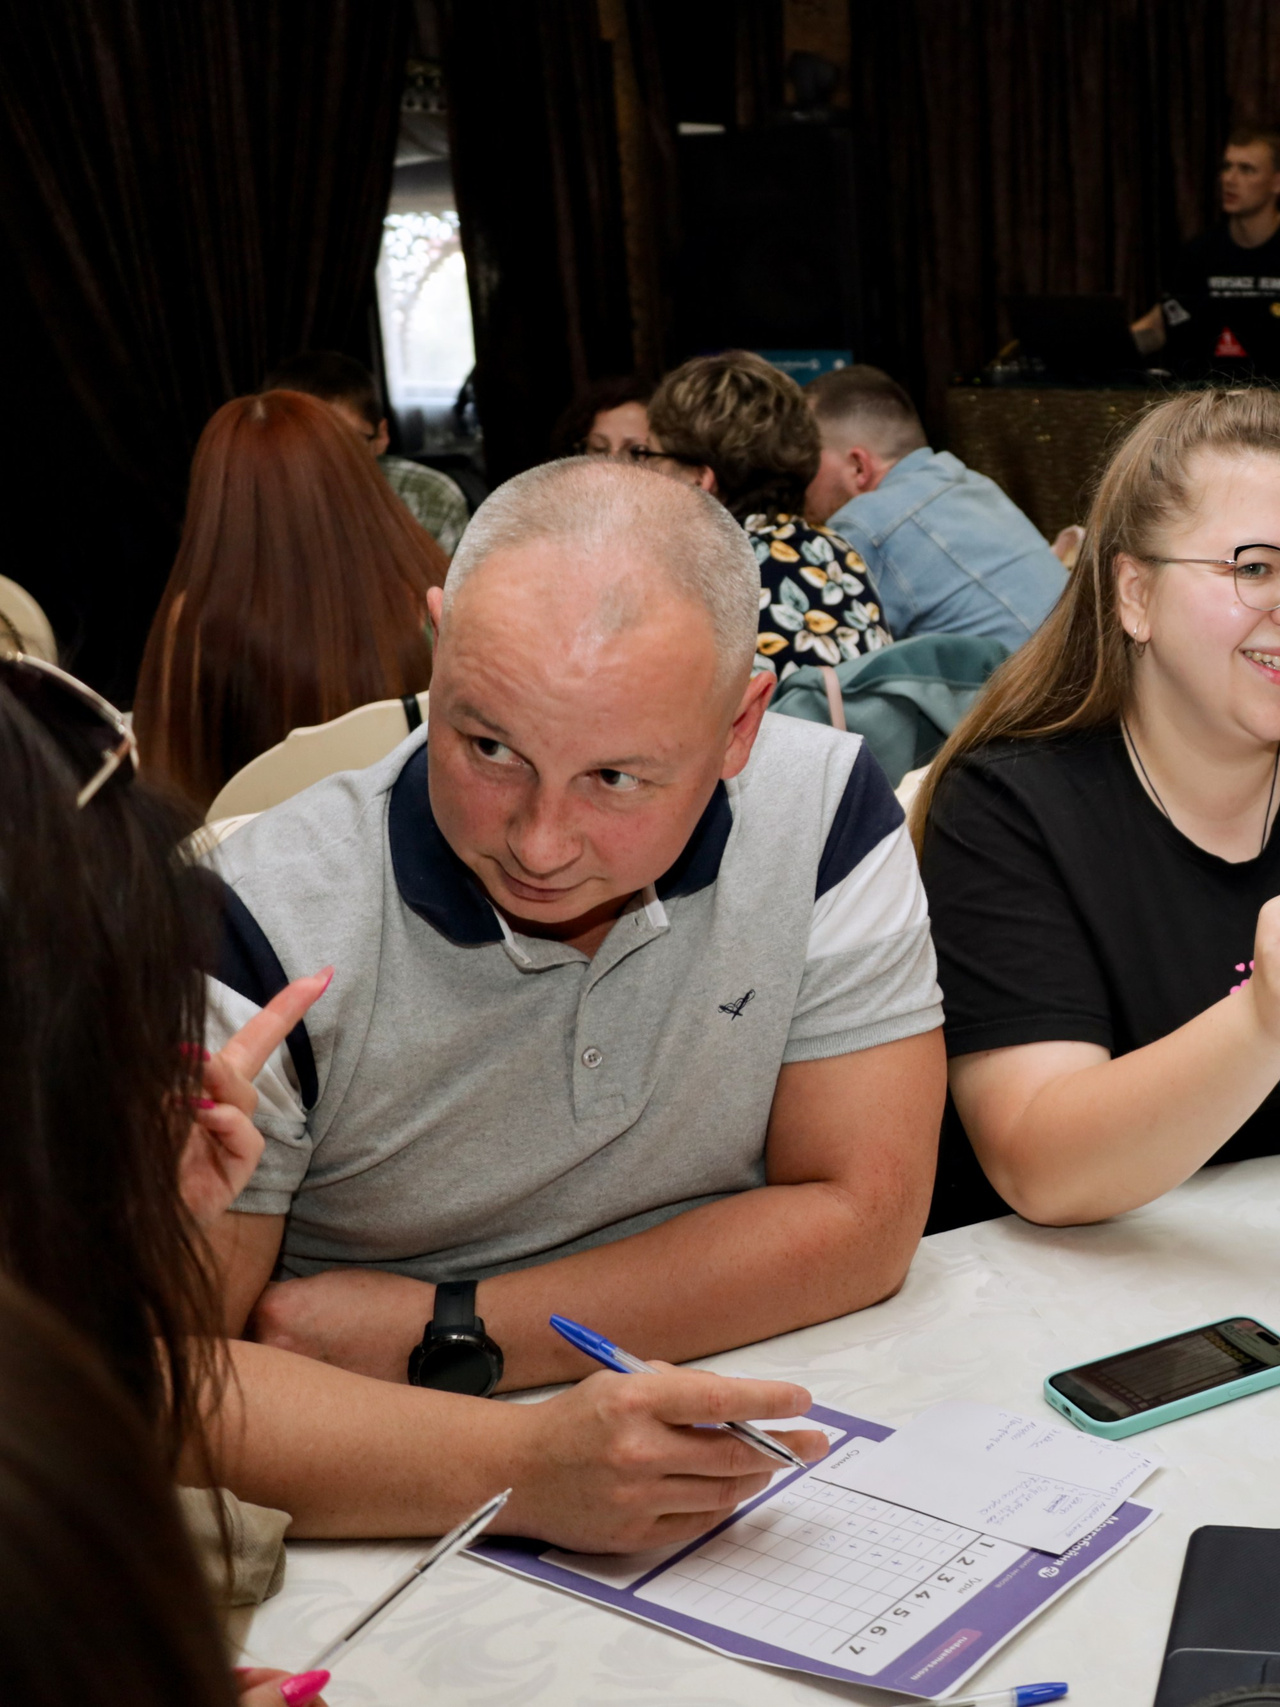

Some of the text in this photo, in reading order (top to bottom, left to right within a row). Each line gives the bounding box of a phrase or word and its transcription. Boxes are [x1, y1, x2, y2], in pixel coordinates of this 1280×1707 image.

[830, 1449, 860, 1470] Сумма
[848, 1540, 995, 1655] 1 2 3 4 5 6 7
[957, 1576, 983, 1594] Туры
[910, 1635, 968, 1681] rudagames.com
